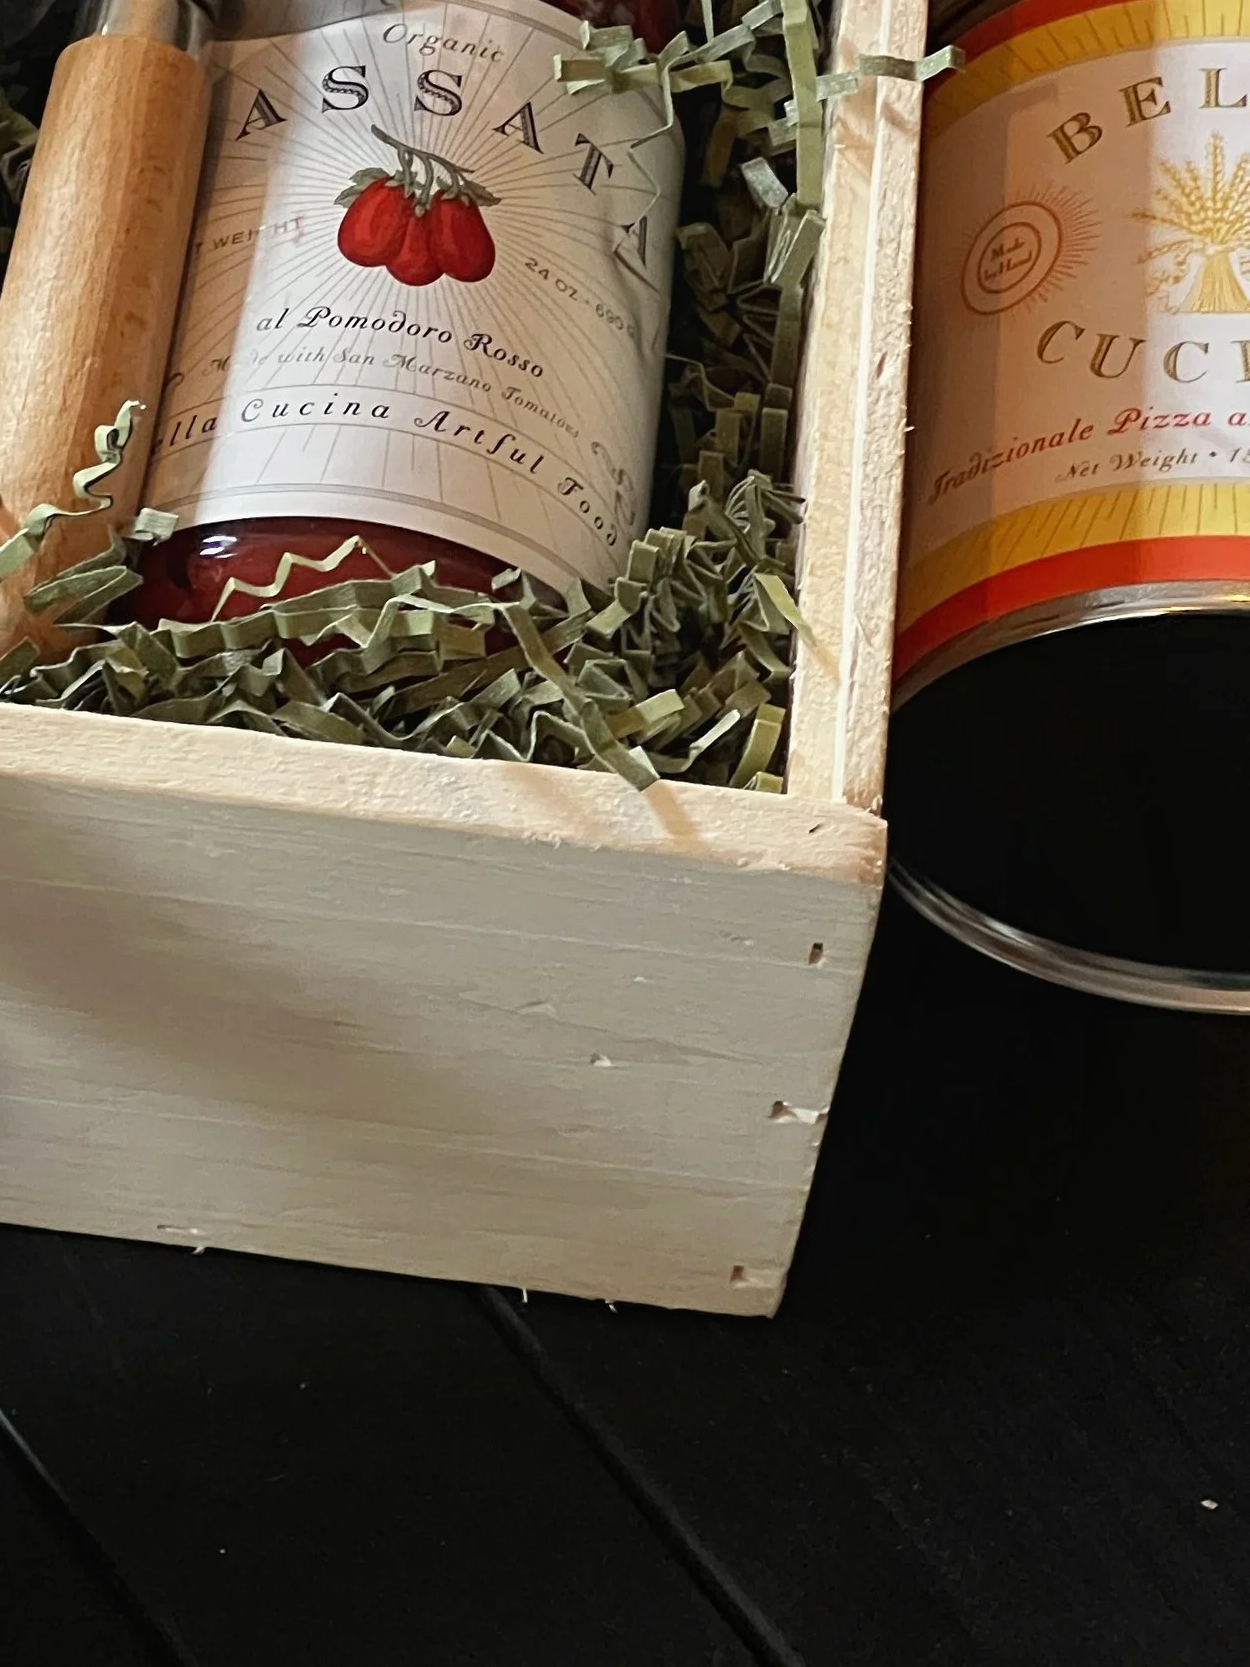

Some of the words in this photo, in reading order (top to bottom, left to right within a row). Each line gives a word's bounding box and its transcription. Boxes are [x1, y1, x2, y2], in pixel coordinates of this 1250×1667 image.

[383, 23, 505, 64] Organic
[1046, 67, 1248, 165] BEL
[234, 64, 648, 269] ASSATA
[213, 216, 305, 250] WEIHT
[525, 257, 550, 280] 24
[554, 278, 578, 302] OZ
[256, 307, 290, 333] al
[297, 305, 452, 344] Pomodoro
[463, 332, 544, 378] Rosso
[277, 346, 326, 365] with
[332, 347, 375, 366] San
[383, 352, 493, 393] Marzano
[241, 392, 391, 423] Cucina
[413, 409, 545, 475] Artful
[557, 476, 618, 547] Food
[927, 417, 1094, 506] Tradizionale
[1107, 405, 1213, 437] Pizza
[1055, 459, 1100, 484] Net
[1109, 448, 1198, 473] Weight
